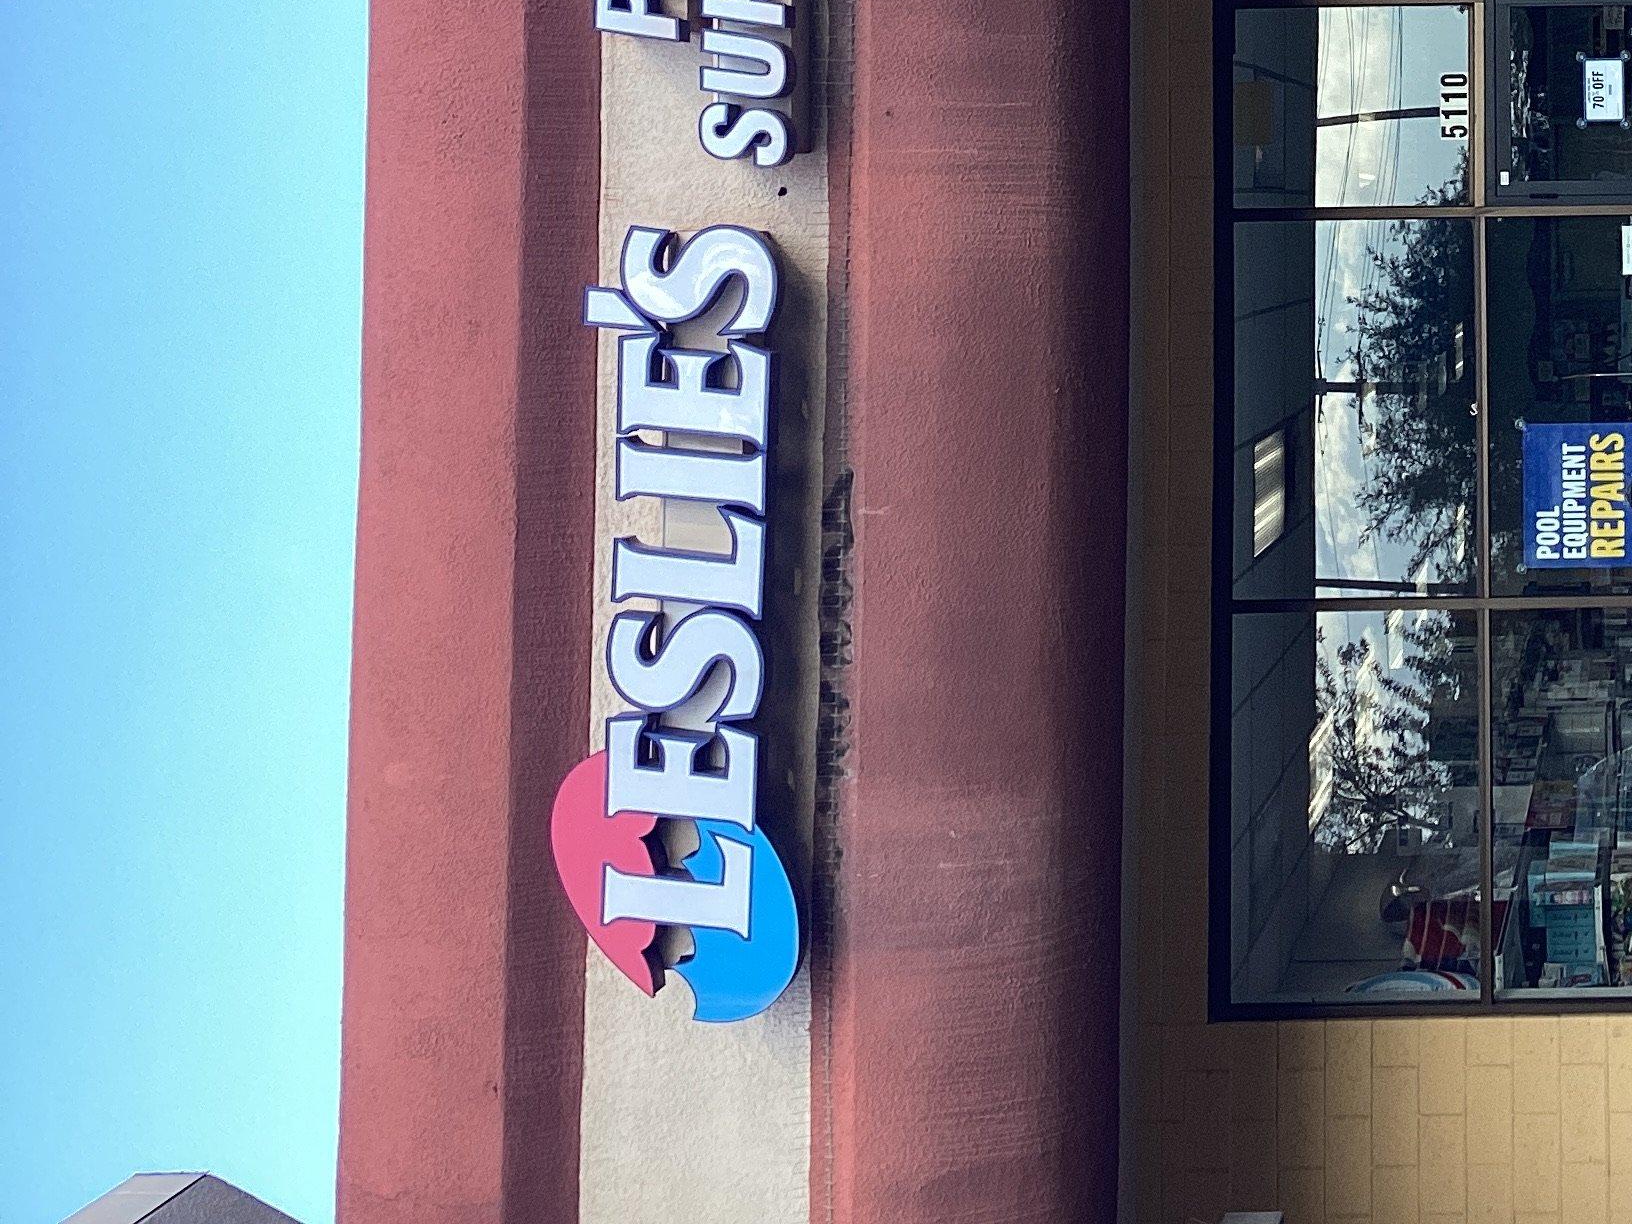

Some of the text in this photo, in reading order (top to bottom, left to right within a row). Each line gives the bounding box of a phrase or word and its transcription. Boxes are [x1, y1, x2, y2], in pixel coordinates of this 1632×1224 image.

[1440, 73, 1468, 139] 5110
[1592, 71, 1604, 90] OFF
[1536, 505, 1560, 560] POOL
[1562, 443, 1588, 559] EQUIPMENT
[1589, 432, 1625, 558] REPAIRS
[582, 223, 778, 941] LESLIE'S
